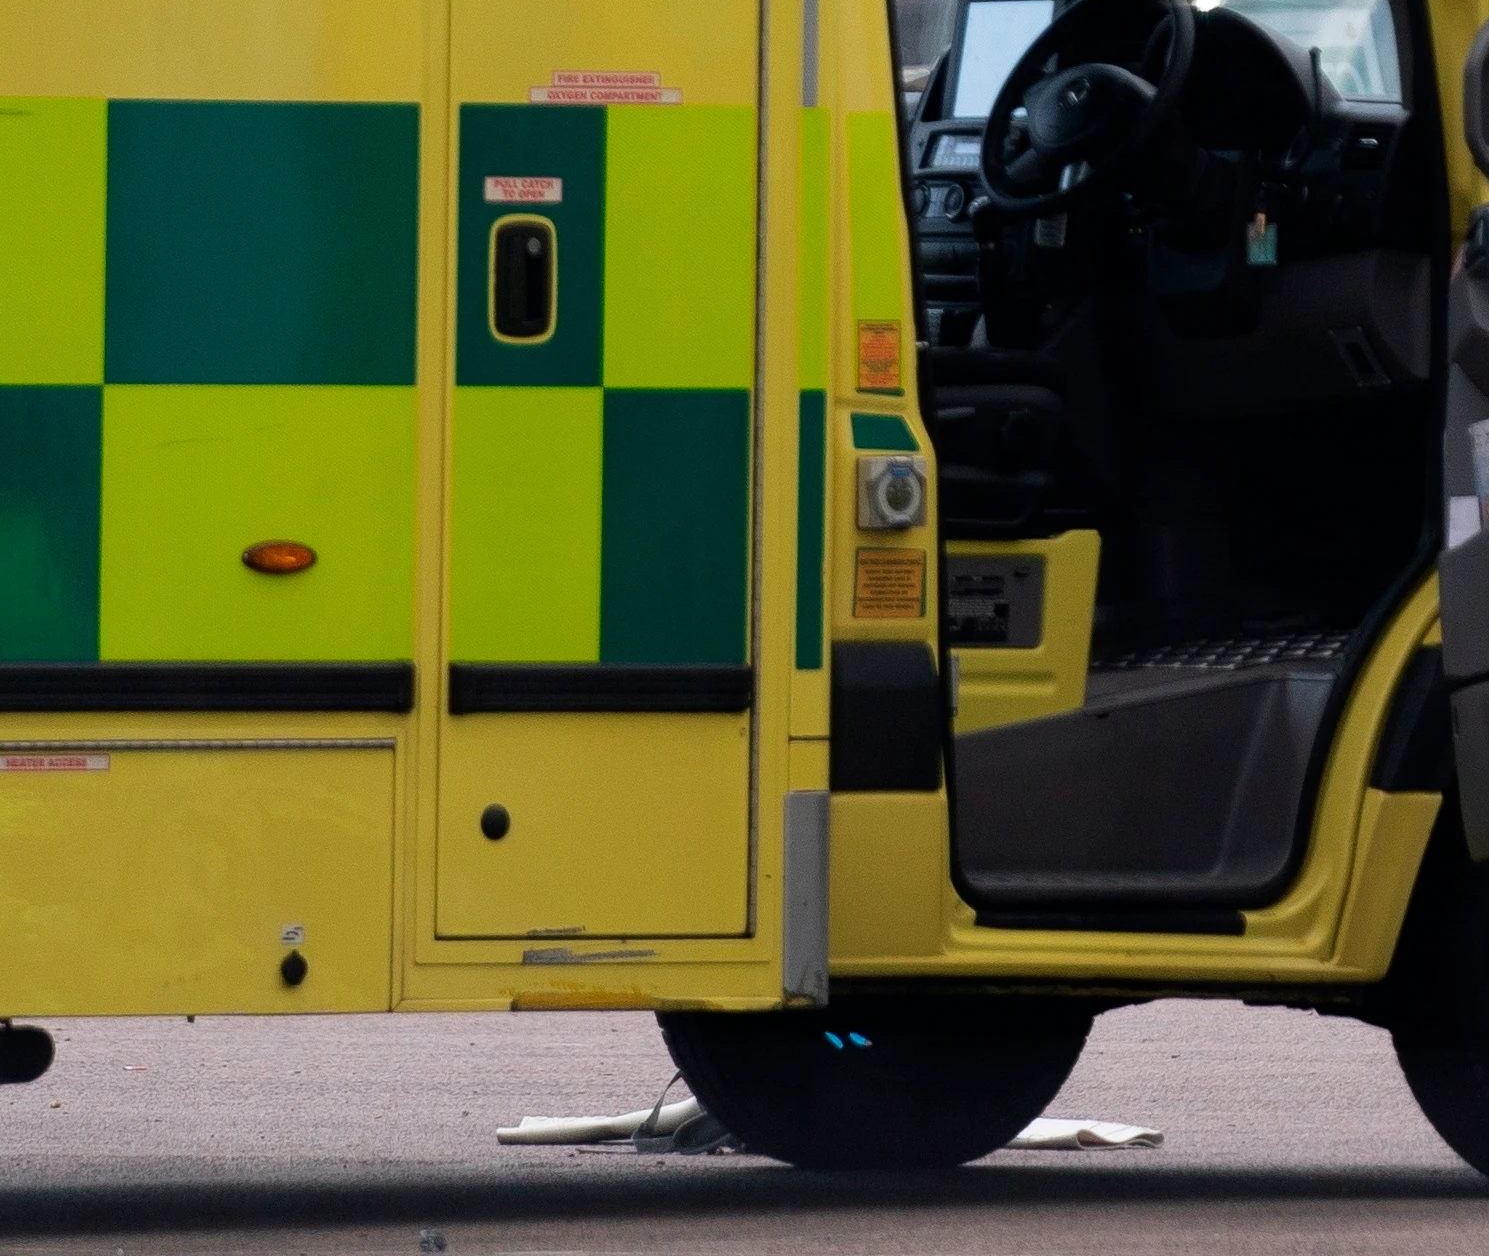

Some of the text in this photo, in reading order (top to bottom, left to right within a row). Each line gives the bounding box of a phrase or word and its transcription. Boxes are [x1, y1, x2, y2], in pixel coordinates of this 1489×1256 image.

[557, 74, 579, 84] FIRE
[547, 90, 662, 101] OXYGEN COMPARTMENT
